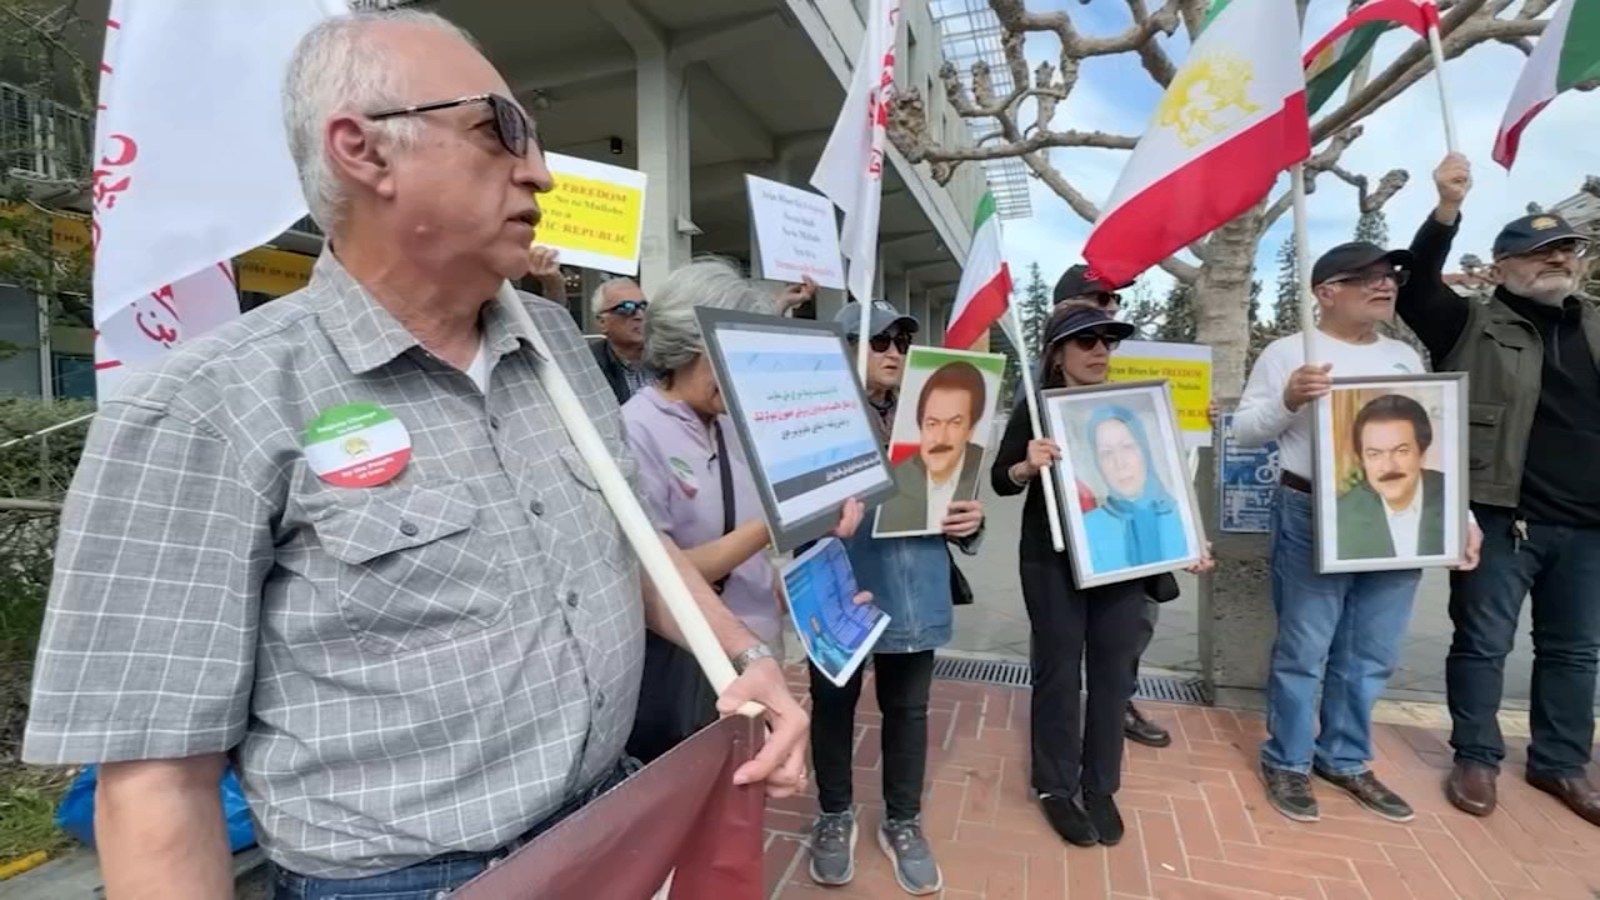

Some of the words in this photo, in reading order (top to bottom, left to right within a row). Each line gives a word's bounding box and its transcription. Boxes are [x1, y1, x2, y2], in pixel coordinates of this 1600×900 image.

[562, 182, 627, 202] FREEDOM
[571, 198, 581, 207] to
[584, 201, 624, 215] Mullahs
[562, 223, 627, 244] REPUBLIC
